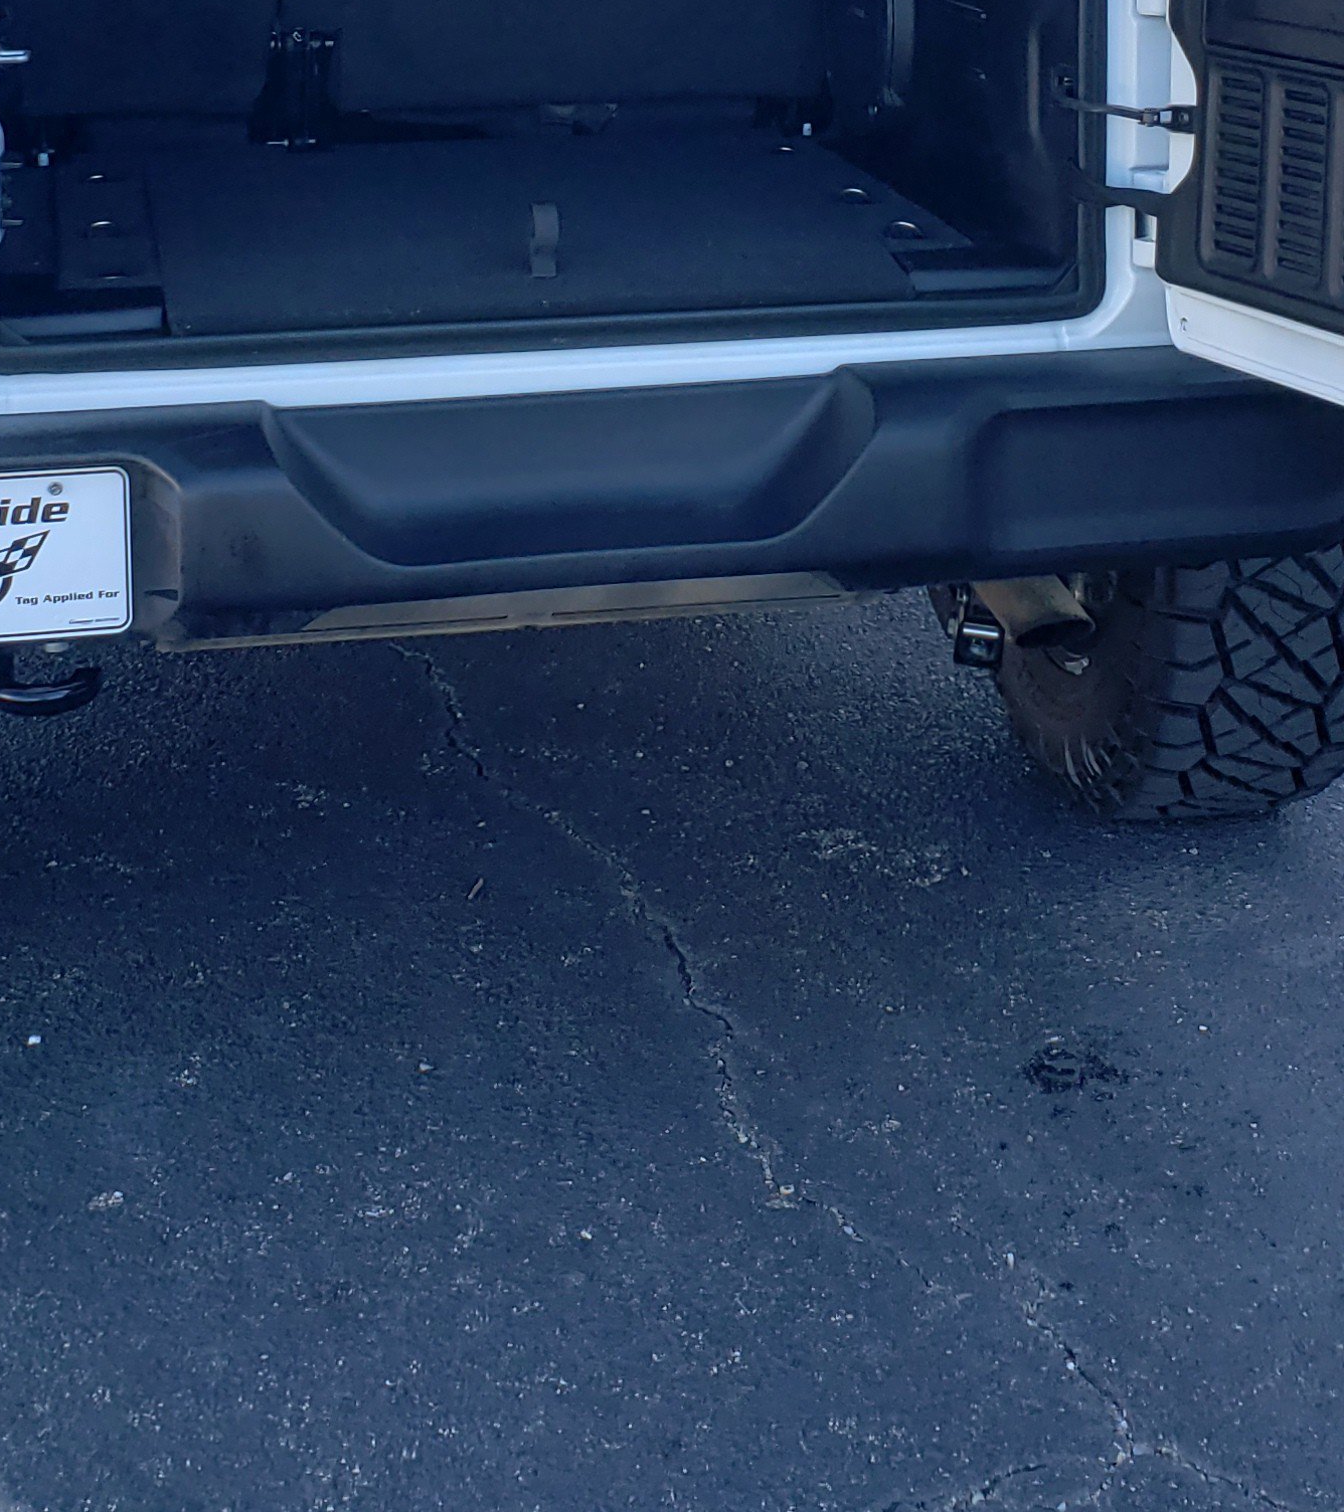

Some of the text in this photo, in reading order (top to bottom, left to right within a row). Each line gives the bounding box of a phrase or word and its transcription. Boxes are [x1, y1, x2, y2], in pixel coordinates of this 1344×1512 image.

[15, 590, 120, 606] Tag Applied For
